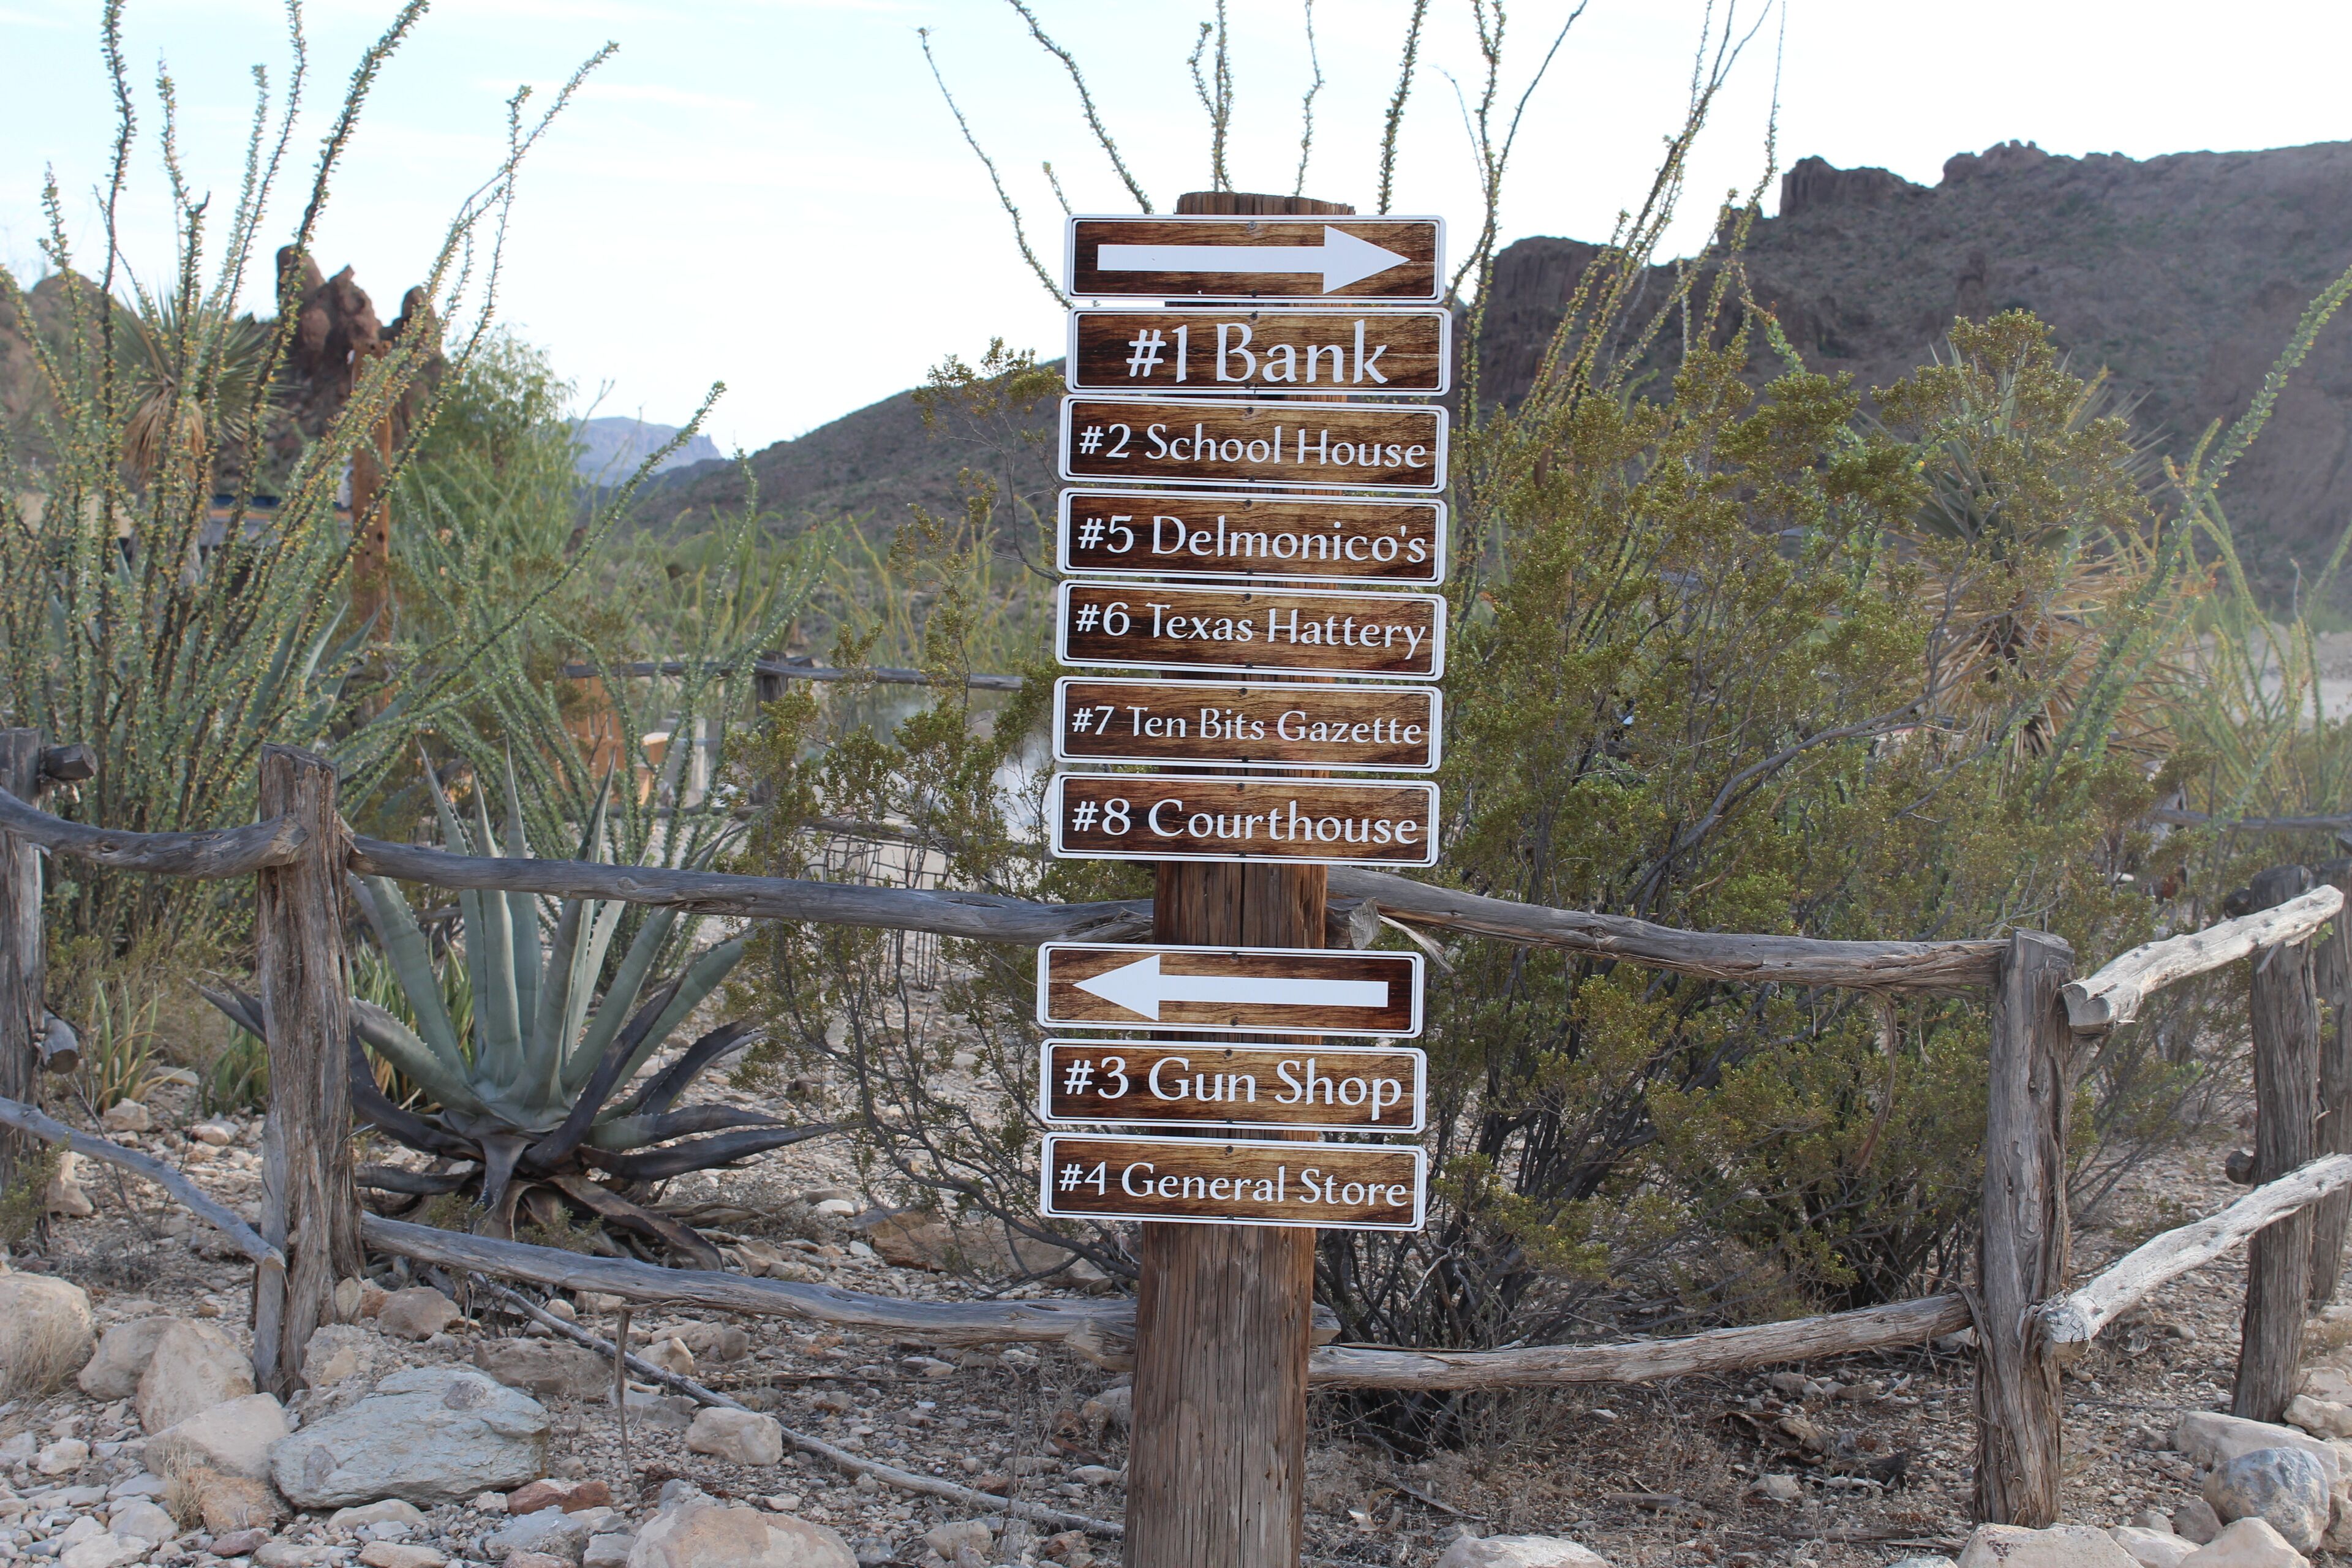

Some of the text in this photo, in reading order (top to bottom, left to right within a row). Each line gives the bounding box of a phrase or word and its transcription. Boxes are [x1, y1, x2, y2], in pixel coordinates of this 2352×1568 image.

[1126, 318, 1388, 384] #1 Bank
[1079, 423, 1427, 468] #2 School House
[1077, 514, 1426, 563] #5 Delmonico's
[1076, 601, 1426, 660] #6 Texas Hattery
[1072, 705, 1422, 745] #7 Ten Bits Gazette
[1072, 798, 1419, 844] #8 Courthouse
[1063, 1056, 1401, 1121] #3 Gun Shop
[1058, 1161, 1408, 1207] #4 General Store
